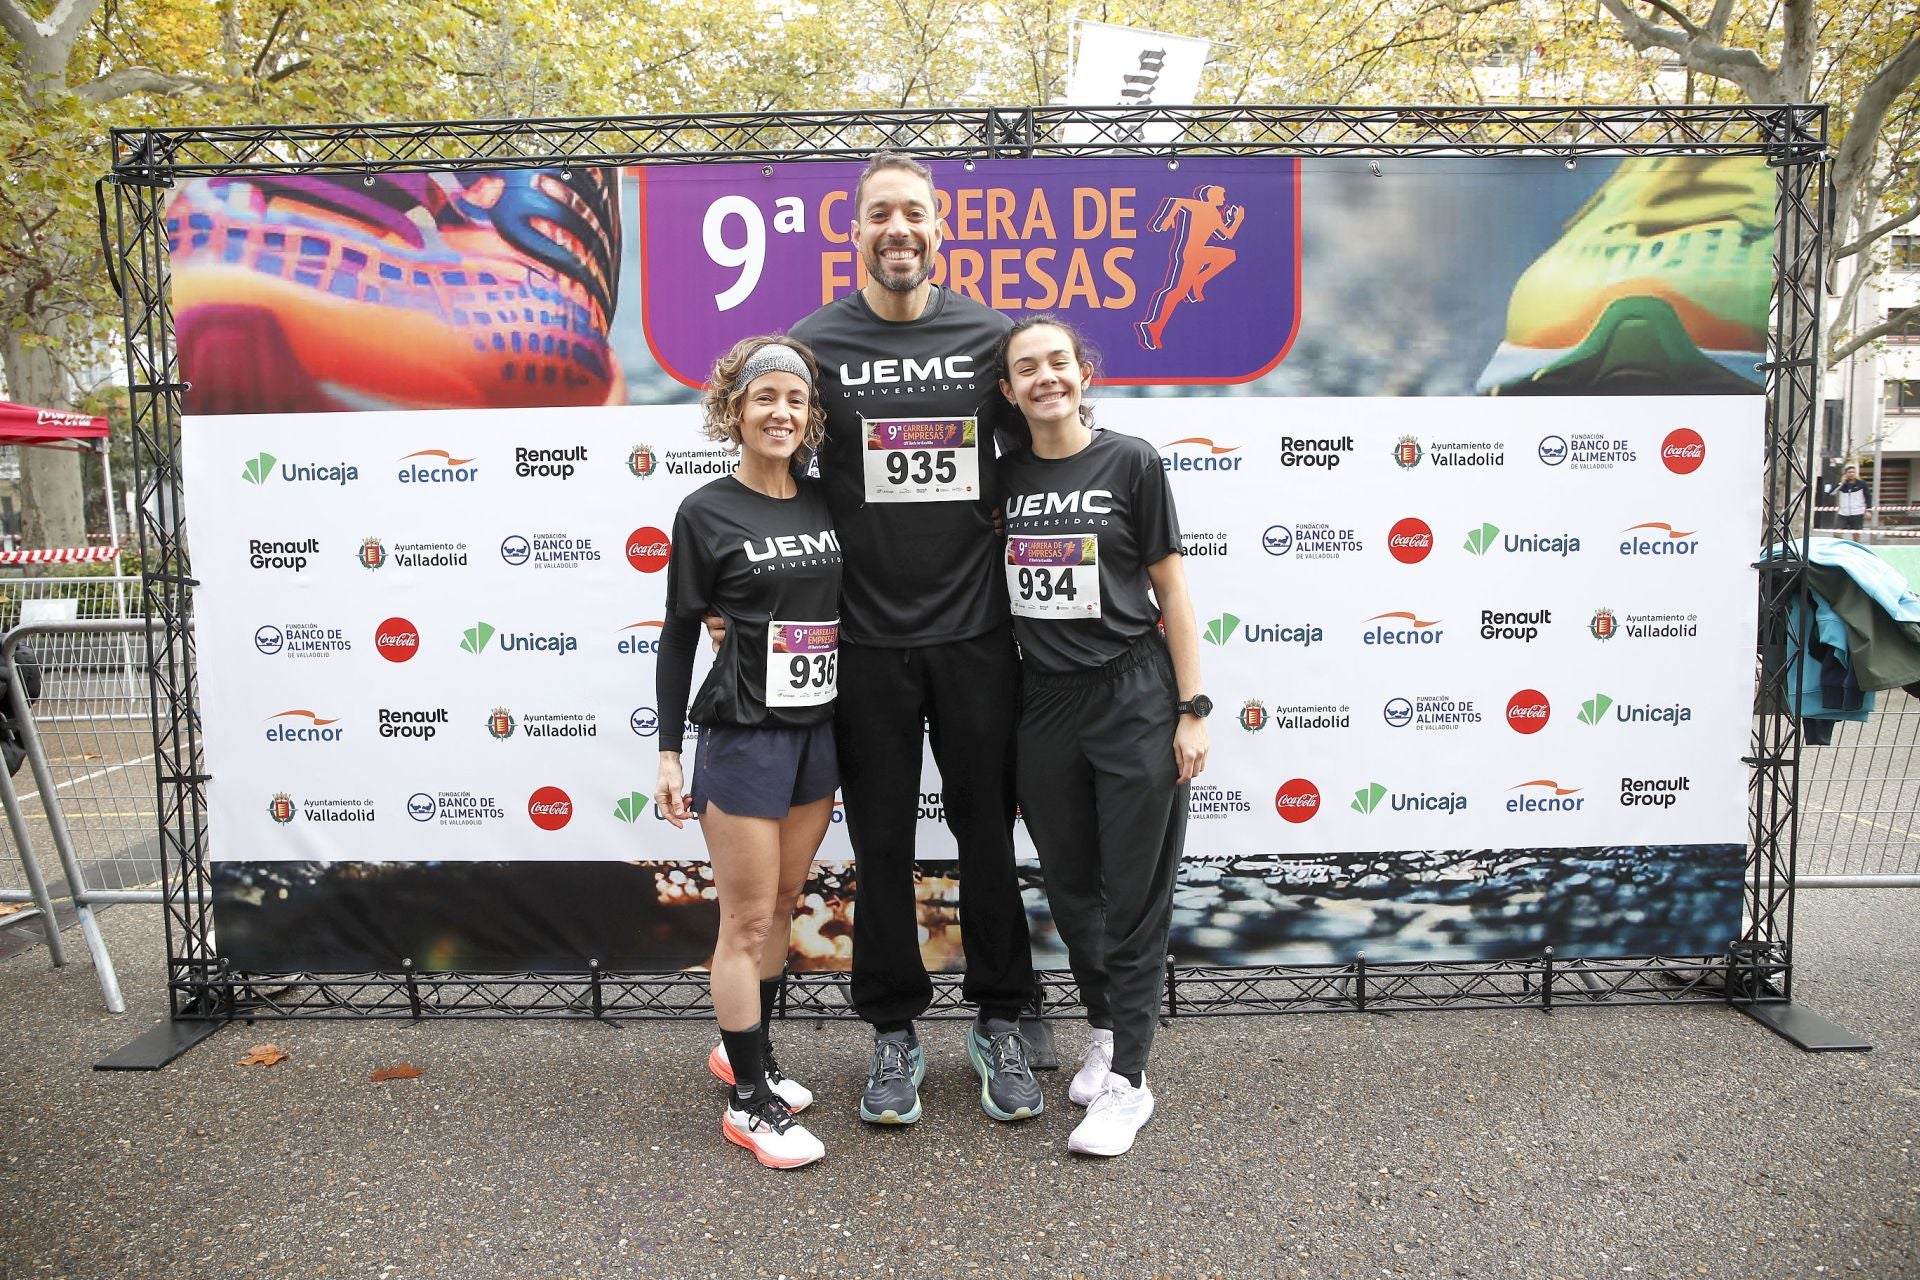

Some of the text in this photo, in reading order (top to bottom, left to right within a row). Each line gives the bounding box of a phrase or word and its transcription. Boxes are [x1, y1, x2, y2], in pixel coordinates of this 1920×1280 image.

[819, 188, 1057, 242] CRERA
[1073, 187, 1137, 239] DE
[821, 247, 1137, 310] ERESAS
[840, 356, 975, 386] UEMC
[843, 383, 976, 398] UNIVERSIDAD
[903, 431, 944, 440] EMPRESAS
[1282, 436, 1353, 451] Renault
[1431, 442, 1491, 451] Ayuntamiento
[1571, 440, 1628, 450] BANCO DE
[1663, 443, 1703, 458] Coca-Cola
[516, 446, 587, 462] Renault
[666, 451, 727, 459] Ayuntamiento
[1281, 452, 1339, 470] Group
[1431, 453, 1503, 466] Valladolid
[1571, 452, 1636, 461] ALIMENTOS
[886, 450, 957, 485] 935
[1161, 452, 1242, 471] elecnor
[282, 462, 358, 485] Unicaja
[399, 464, 478, 483] elecnor
[516, 462, 574, 480] Group
[1006, 490, 1113, 519] UEMC
[1009, 519, 1108, 529] NIVERSIDAD
[1296, 530, 1354, 540] BANCO DE
[1391, 533, 1430, 547] Coca-Cola
[250, 539, 319, 554] Renault
[395, 542, 466, 552] Ayuntamiento de
[534, 539, 591, 550] BANCO DE
[629, 542, 667, 556] Coca-Cola
[743, 530, 841, 562] UEM
[1182, 543, 1227, 555] adolid
[1296, 542, 1362, 551] ALIMENTOS
[1505, 534, 1580, 557] Unicaja
[1620, 537, 1698, 555] elecnor
[250, 554, 306, 572] Group
[395, 553, 467, 566] Valladolid
[535, 551, 600, 561] ALIMENTOS
[753, 556, 843, 575] UNIVERSID
[1018, 567, 1077, 601] 934
[1482, 610, 1551, 624] Renault
[1626, 615, 1684, 623] Ayuntamiento
[286, 630, 342, 639] BANCO DE
[1245, 624, 1322, 647] Unicaja
[1364, 626, 1443, 644] elecnor
[1481, 625, 1537, 642] Group
[1626, 624, 1696, 637] Valladolid
[288, 641, 351, 650] ALIMENTOS
[378, 632, 415, 646] Coca-Cola
[501, 633, 577, 656] Unicaja
[617, 636, 658, 653] elec
[789, 653, 836, 688] 936
[1277, 705, 1336, 713] Ayuntamiento
[1417, 702, 1473, 712] BANCO DE
[1509, 705, 1547, 718] Coca-Cola
[379, 709, 448, 723] Renault
[524, 714, 583, 722] Ayuntamiento
[1277, 715, 1349, 728] Valladolid
[1417, 713, 1481, 723] ALIMENTOS
[1617, 704, 1691, 726] Unicaja
[267, 724, 343, 741] elecnor
[379, 723, 435, 741] Group
[524, 724, 596, 736] Valladolid
[1622, 777, 1689, 791] Renault
[304, 799, 361, 807] Ayuntamiento
[439, 798, 495, 807] BANCO DE
[1190, 791, 1242, 801] ANCO DE
[1278, 794, 1317, 807] Coca-Cola
[1506, 794, 1584, 812] elecnor
[1620, 792, 1676, 809] Group
[531, 802, 568, 815] Coca-Cola
[1392, 792, 1466, 815] Unicaja
[305, 809, 374, 821] Valladolid
[440, 809, 504, 818] ALIMENTOS
